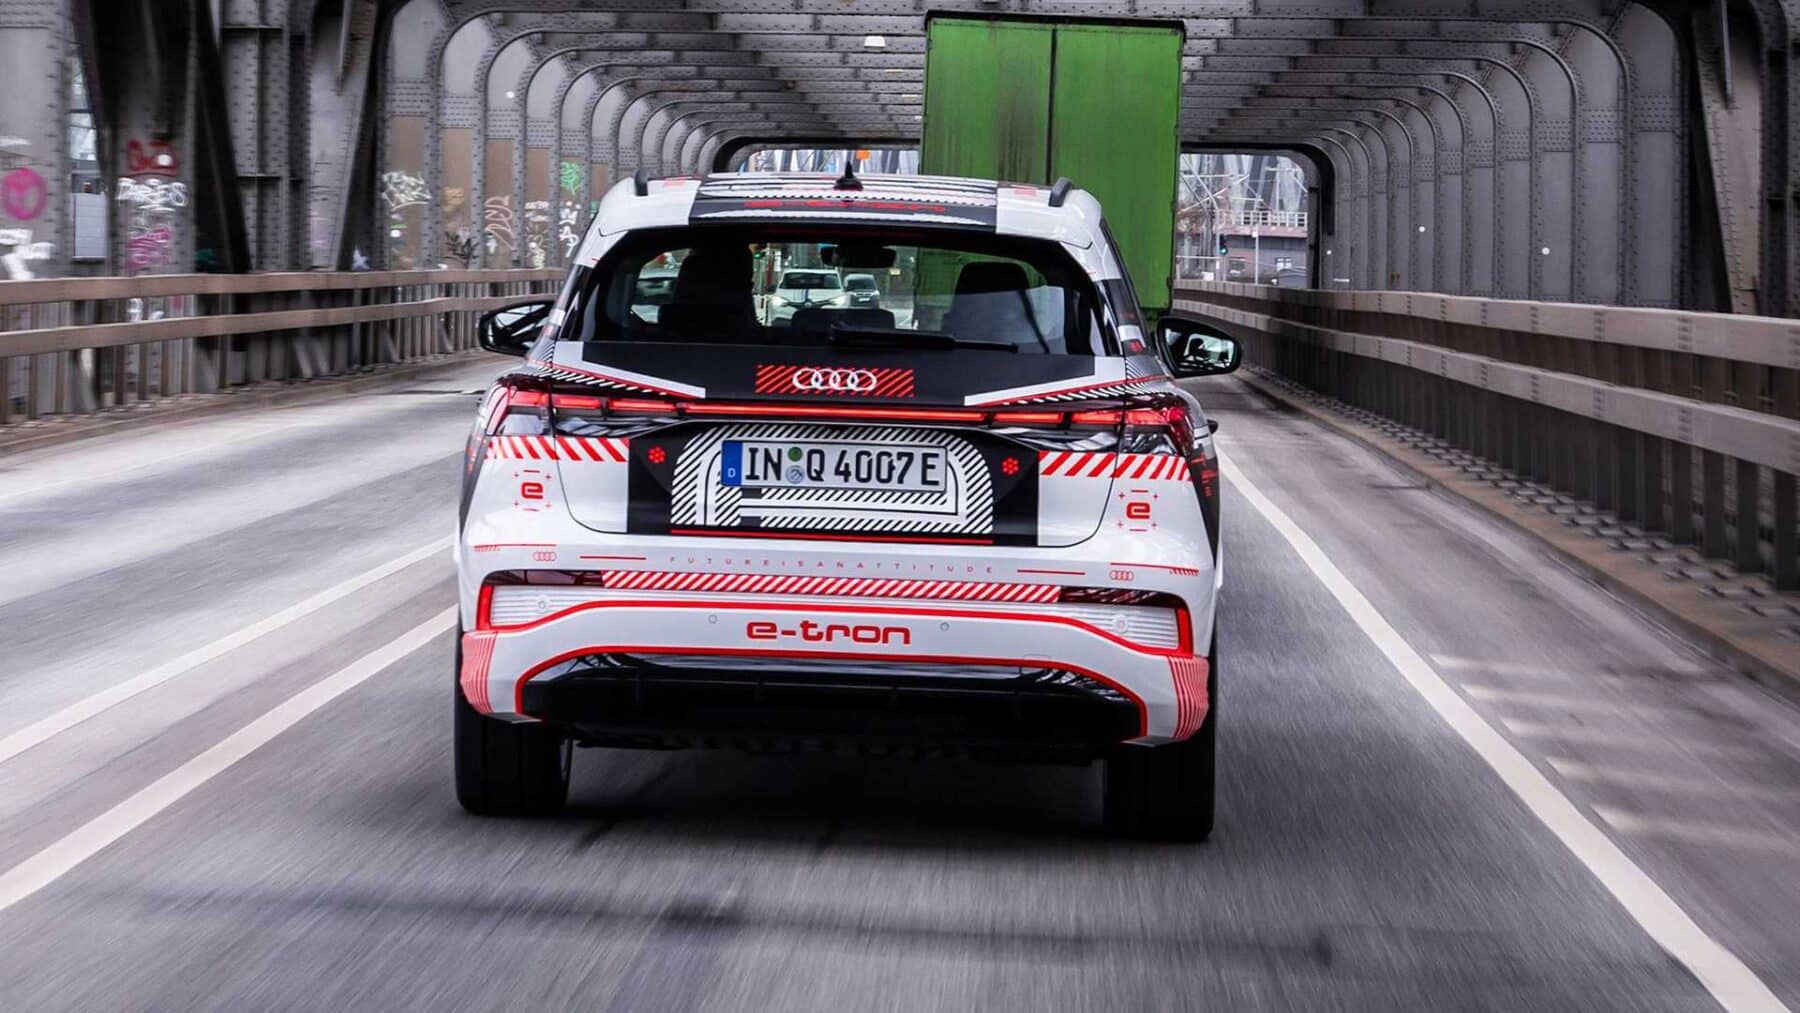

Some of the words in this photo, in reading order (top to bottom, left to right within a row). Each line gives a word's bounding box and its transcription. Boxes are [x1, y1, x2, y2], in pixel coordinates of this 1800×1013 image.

[728, 468, 736, 478] D
[745, 447, 783, 481] IN
[806, 448, 825, 482] Q
[746, 621, 911, 645] e-tron
